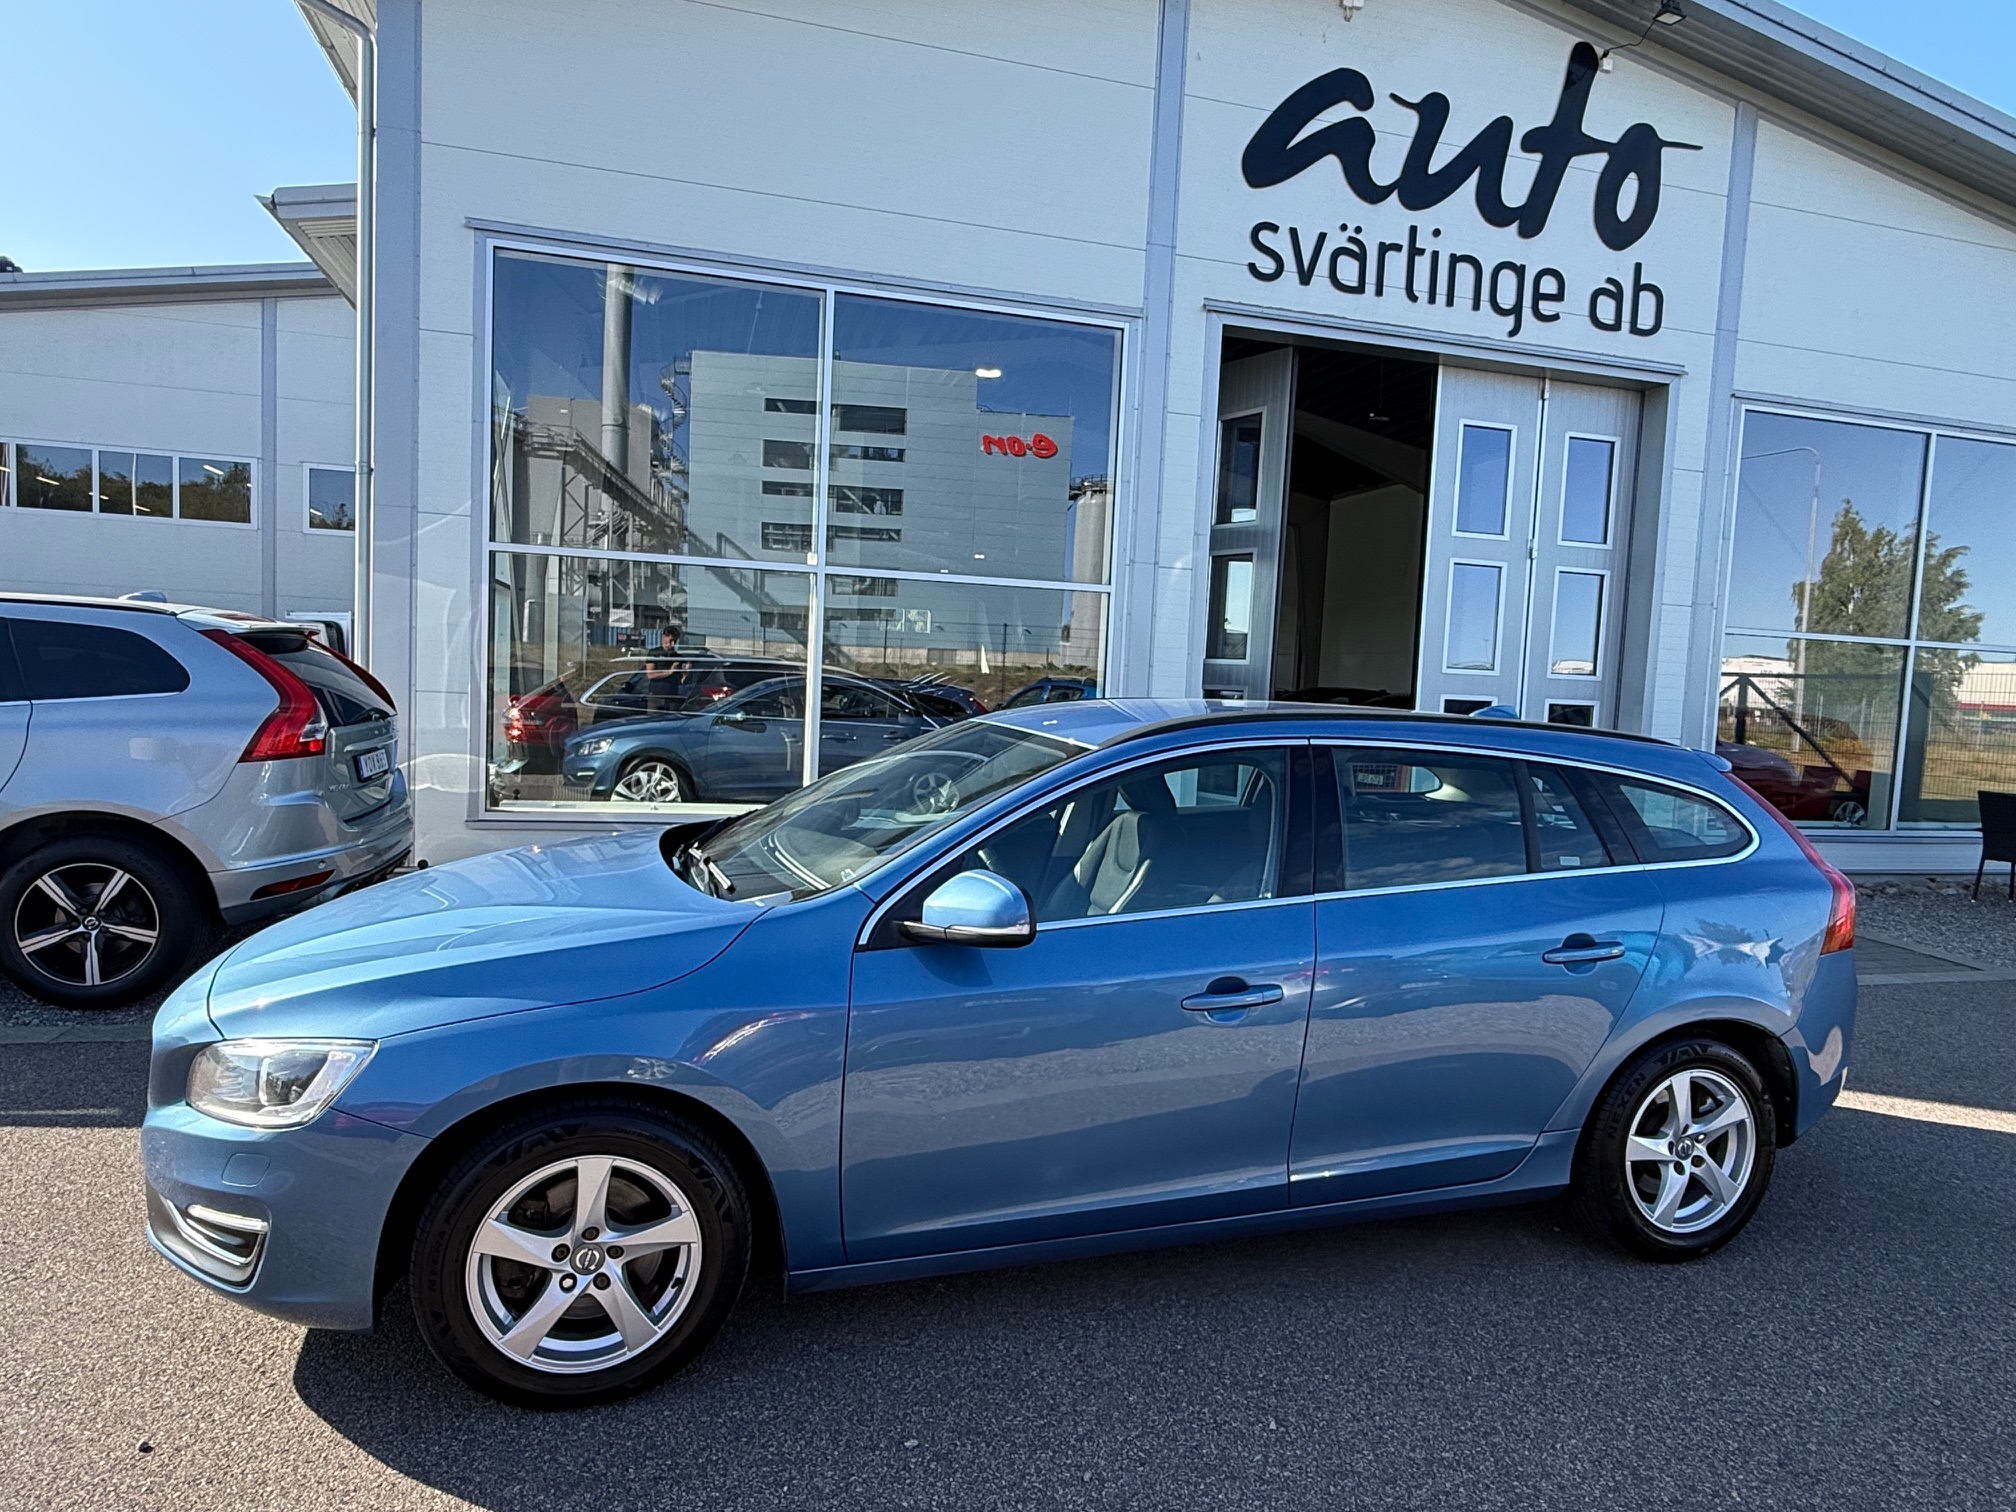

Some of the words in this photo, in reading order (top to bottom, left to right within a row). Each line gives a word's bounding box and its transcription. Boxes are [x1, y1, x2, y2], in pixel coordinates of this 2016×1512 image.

[1242, 41, 1703, 251] auto
[1248, 221, 1566, 338] svärtinge
[1589, 262, 1664, 337] ab
